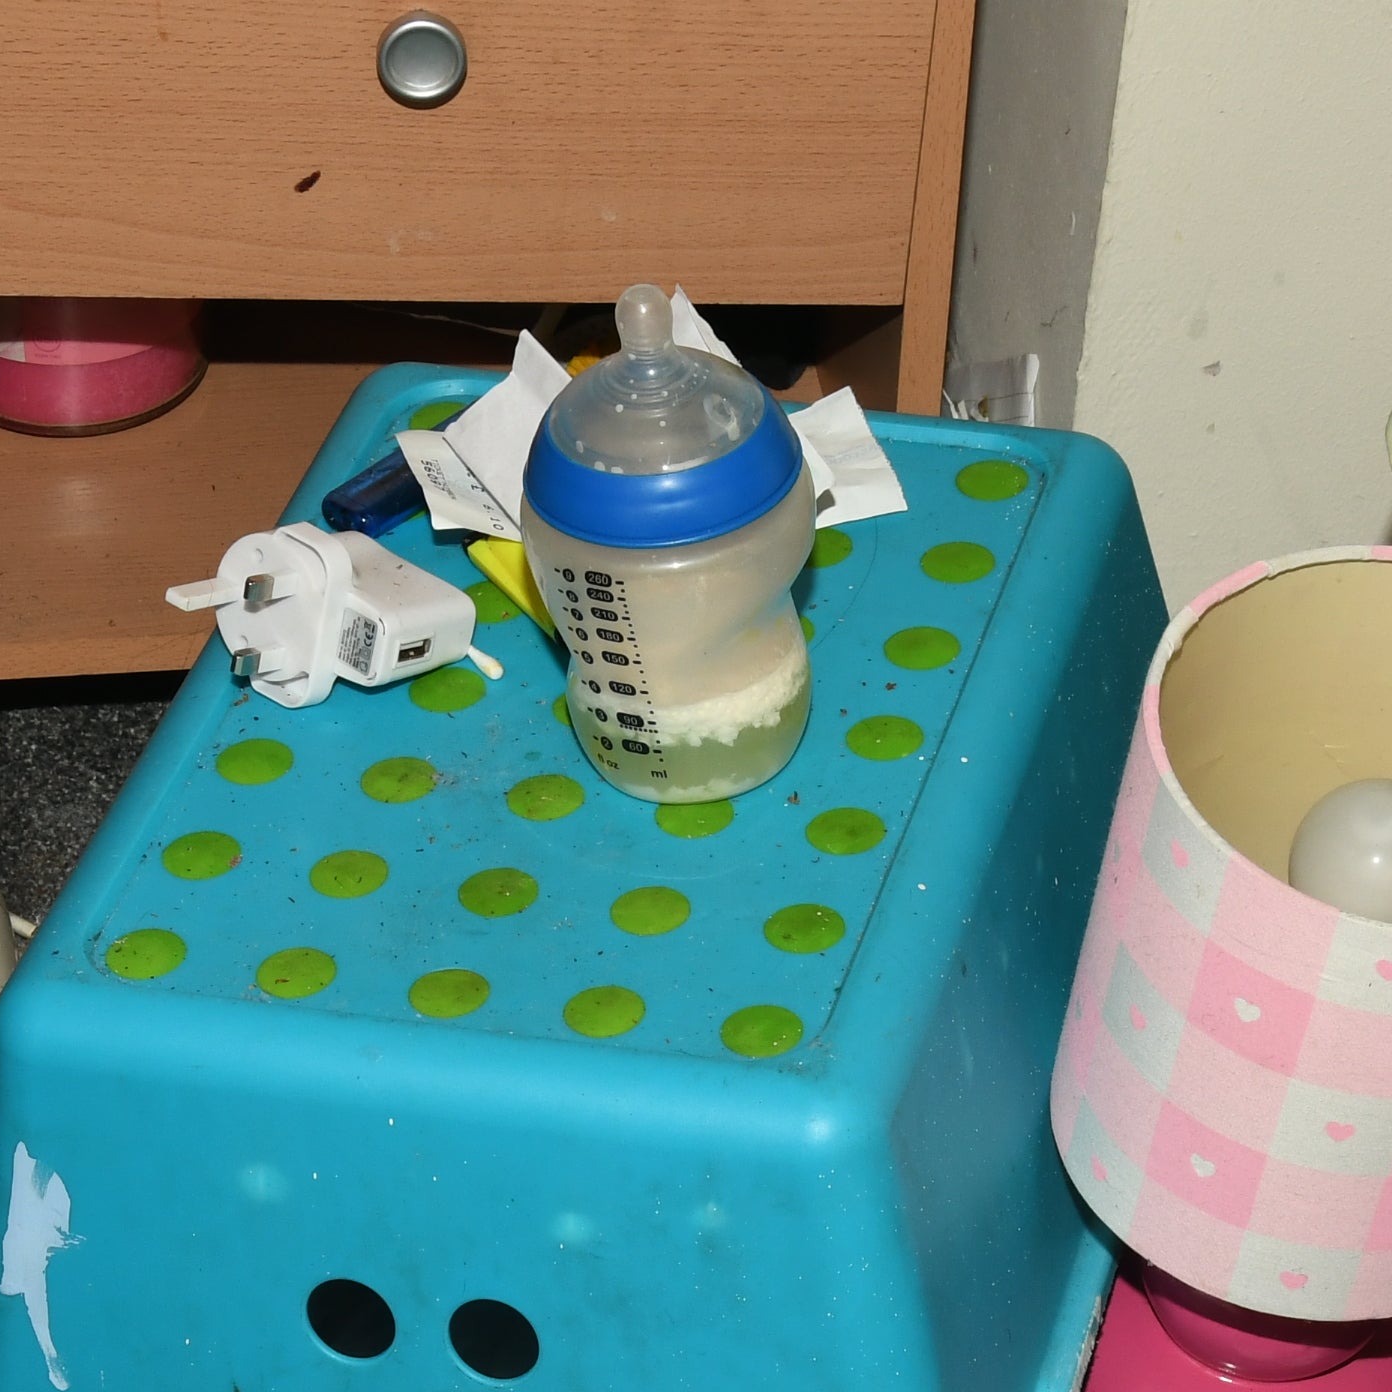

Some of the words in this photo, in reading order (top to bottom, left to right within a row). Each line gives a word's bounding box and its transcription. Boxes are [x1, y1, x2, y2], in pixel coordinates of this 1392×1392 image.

[587, 572, 609, 586] 260
[590, 589, 611, 601] 240
[594, 609, 616, 620] 210
[599, 630, 621, 641] 180
[605, 653, 626, 665] 150
[612, 682, 632, 694] 120
[622, 714, 638, 725] 90
[628, 742, 644, 752] 60
[606, 759, 619, 770] oz
[651, 769, 668, 779] ml
